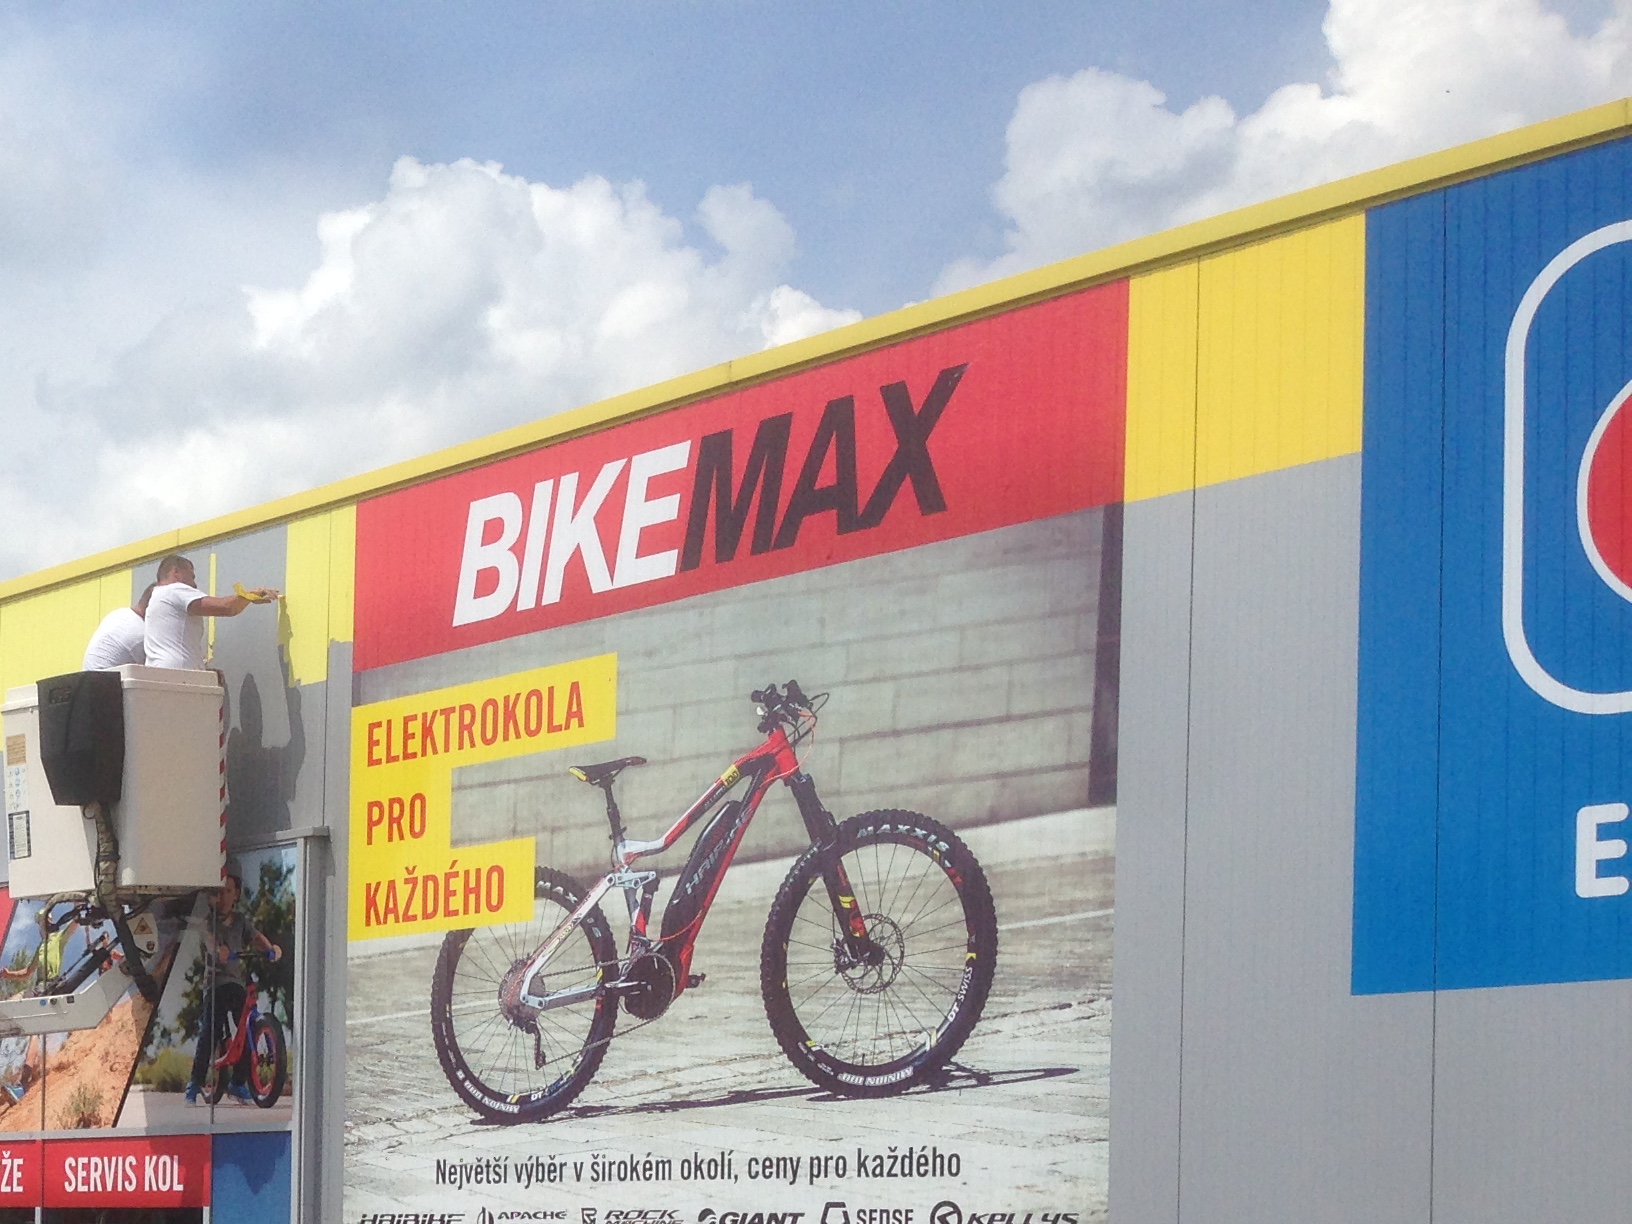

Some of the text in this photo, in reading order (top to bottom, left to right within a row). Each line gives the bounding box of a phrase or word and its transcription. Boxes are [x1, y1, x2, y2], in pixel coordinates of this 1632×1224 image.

[451, 362, 970, 627] BIKEMAX
[366, 680, 585, 767] ELEKTROKOLA
[366, 790, 427, 847] PRO
[365, 858, 505, 928] KAŽDÉHO
[64, 1155, 184, 1192] SERVIS KOL
[435, 1145, 961, 1191] Největší výběr v širokém okolí, ceny pro každého
[497, 1210, 568, 1220] APACHE
[603, 1209, 681, 1219] ROCK
